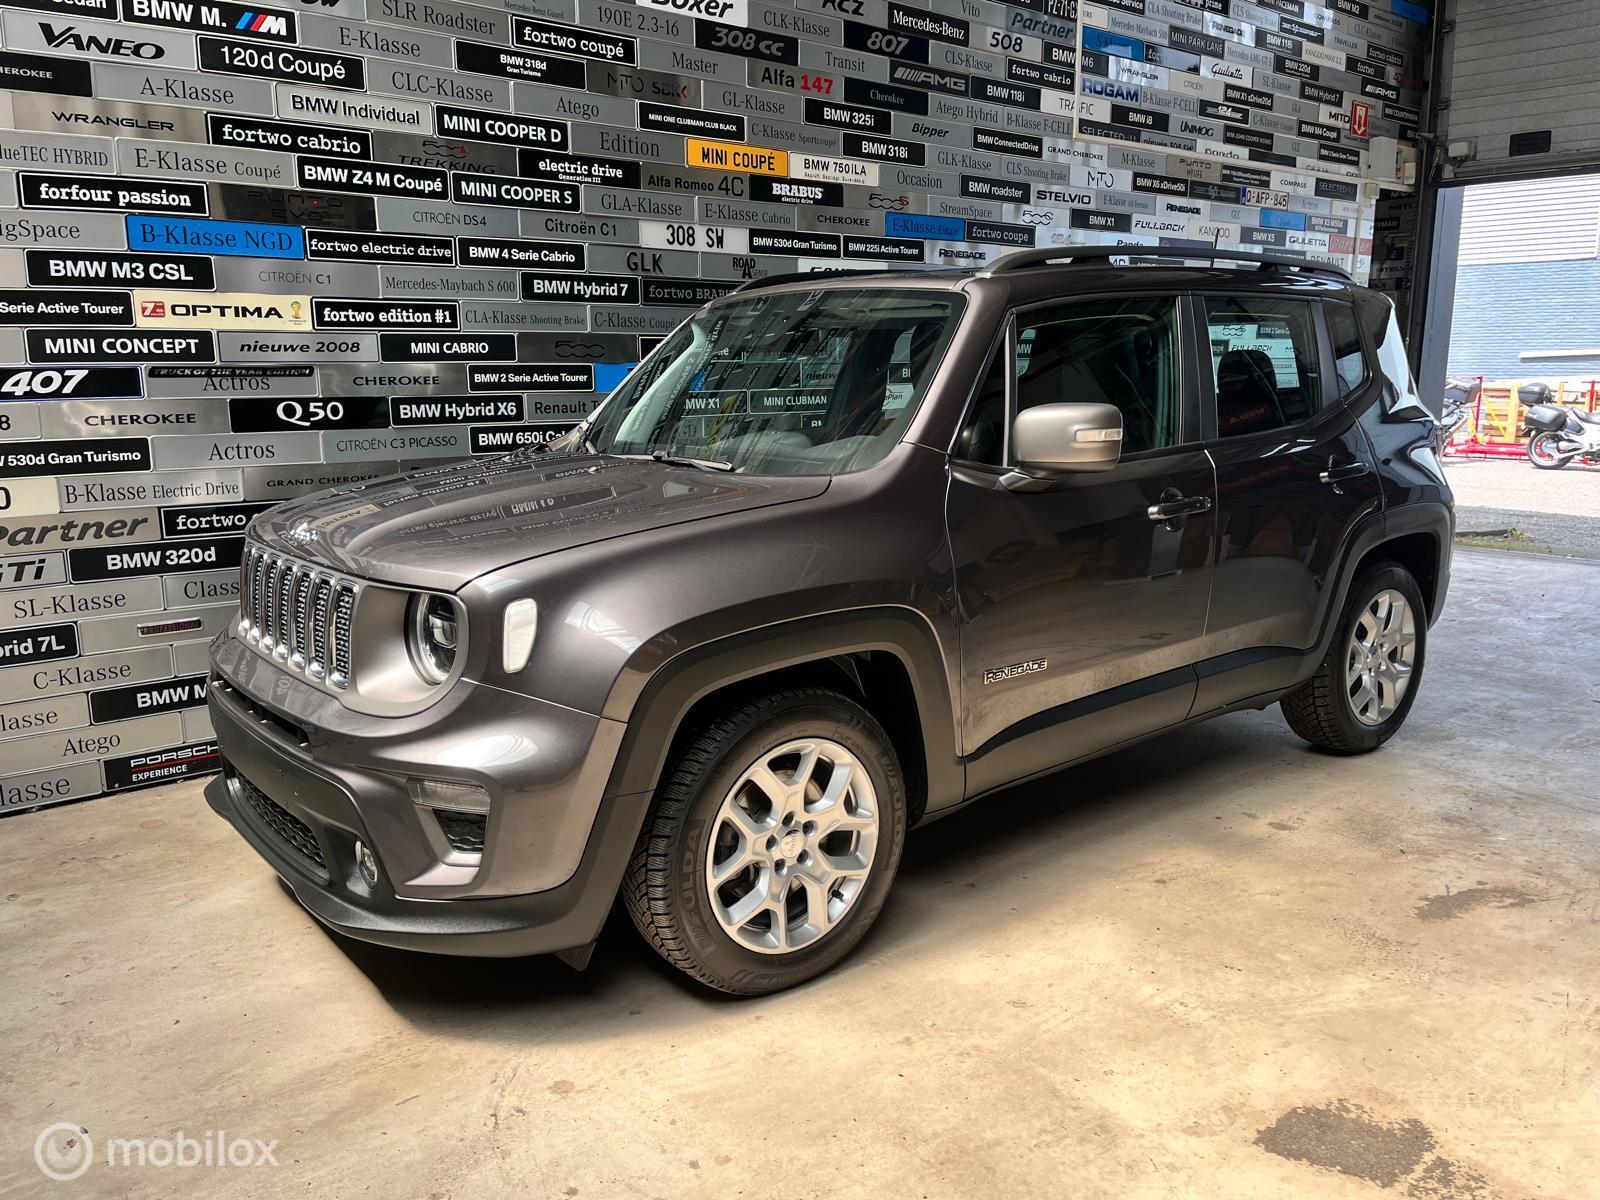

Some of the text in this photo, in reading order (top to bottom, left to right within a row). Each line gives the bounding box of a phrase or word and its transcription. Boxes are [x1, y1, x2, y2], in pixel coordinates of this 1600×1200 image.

[133, 0, 227, 27] BMW M.
[382, 0, 495, 35] SLR Roadster
[598, 6, 679, 37] 190E 2.3-16
[764, 10, 830, 38] CLK-Klasse
[893, 9, 965, 40] Mercedes-Benz
[38, 22, 165, 59] VANEO
[524, 27, 624, 58] fortwo coupé
[711, 26, 755, 50] 308
[867, 31, 909, 55] 807
[990, 31, 1023, 53] 508
[1171, 33, 1223, 53] MINI PARK LANE
[220, 46, 346, 80] 120d Coupé
[500, 54, 547, 70] BMW 318d
[671, 51, 719, 74] Master
[825, 51, 865, 73] Transit
[945, 50, 993, 72] CLS-Klasse
[761, 67, 834, 94] Alfa 147
[1011, 64, 1071, 85] fortwo cabrio
[1262, 75, 1291, 92] SL-Klasse
[140, 77, 234, 104] A-Klasse
[392, 71, 493, 102] CLC-Klasse
[870, 89, 905, 105] Cherokee
[987, 84, 1025, 102] BMW 118i
[291, 94, 420, 125] BMW Individual
[556, 96, 600, 120] Atego
[722, 91, 785, 115] GL-Klasse
[936, 100, 998, 124] Atego Hybrid
[51, 111, 175, 131] WRANGLER
[823, 107, 875, 127] BMW 325i
[1129, 112, 1145, 123] BMW
[222, 124, 361, 154] fortwo cabrio
[443, 114, 562, 143] MINI COOPER D
[911, 123, 949, 139] Bipper
[599, 131, 660, 157] Edition
[977, 133, 1039, 153] BMW ConnectedDrive
[1047, 145, 1103, 161] GRAND CHEROKEE
[136, 148, 281, 179] E-Klasse Coupé
[539, 160, 623, 179] electric drive
[701, 147, 776, 171] MINI COUPÉ
[938, 151, 992, 171] GLK-Klasse
[1121, 152, 1155, 169] M-Klasse
[304, 165, 443, 194] BMW Z4 M Coupé
[648, 174, 744, 197] Alfa Romeo 4C
[897, 170, 942, 188] Occasion
[968, 181, 1023, 199] BMW roadster
[1280, 179, 1307, 189] COMPASS
[40, 183, 191, 206] forfour passion
[772, 183, 824, 199] BRABUS
[1036, 190, 1091, 205] STELVIO
[601, 193, 682, 217] GLA-Klasse
[704, 203, 791, 225] E-Klasse Cabrio
[940, 201, 993, 219] StreamSpace
[545, 218, 617, 237] Citroën C1
[817, 214, 870, 227] CHEROKEE
[1089, 215, 1115, 226] BMW X1
[141, 223, 293, 251] B-Klasse NGD
[666, 224, 724, 249] 308 SW
[753, 237, 837, 251] BMW 530d Gran Turismo
[311, 239, 451, 258] fortwo electric drive
[469, 246, 575, 262] BMW 4 Serie Cabrio
[49, 260, 193, 281] BMW M3 CSL
[627, 251, 663, 273] GLK
[386, 276, 516, 293] Mercedes-Maybach S 600
[171, 304, 284, 319] OPTIMA
[323, 307, 451, 323] fortwo edition #1
[44, 338, 199, 354] MINI CONCEPT
[239, 340, 361, 353] nieuwe 2008
[0, 369, 89, 396] 407
[203, 376, 271, 391] Actros
[474, 373, 588, 383] BMW 2 Serie Active Tourer
[400, 402, 517, 420] BMW Hybrid X6
[763, 395, 827, 406] MINI CLUBMAN
[85, 413, 197, 426] CHEROKEE
[337, 435, 457, 451] CITROËN C3 PICASSO
[64, 482, 239, 504] B-Klasse Electric Drive
[106, 546, 217, 571] BMW 320d
[14, 593, 126, 619] SL-Klasse
[33, 664, 131, 690] C-Klasse
[983, 658, 1048, 684] RENEGADE
[63, 734, 121, 757] Atego
[132, 765, 188, 781] EXPERIENCE
